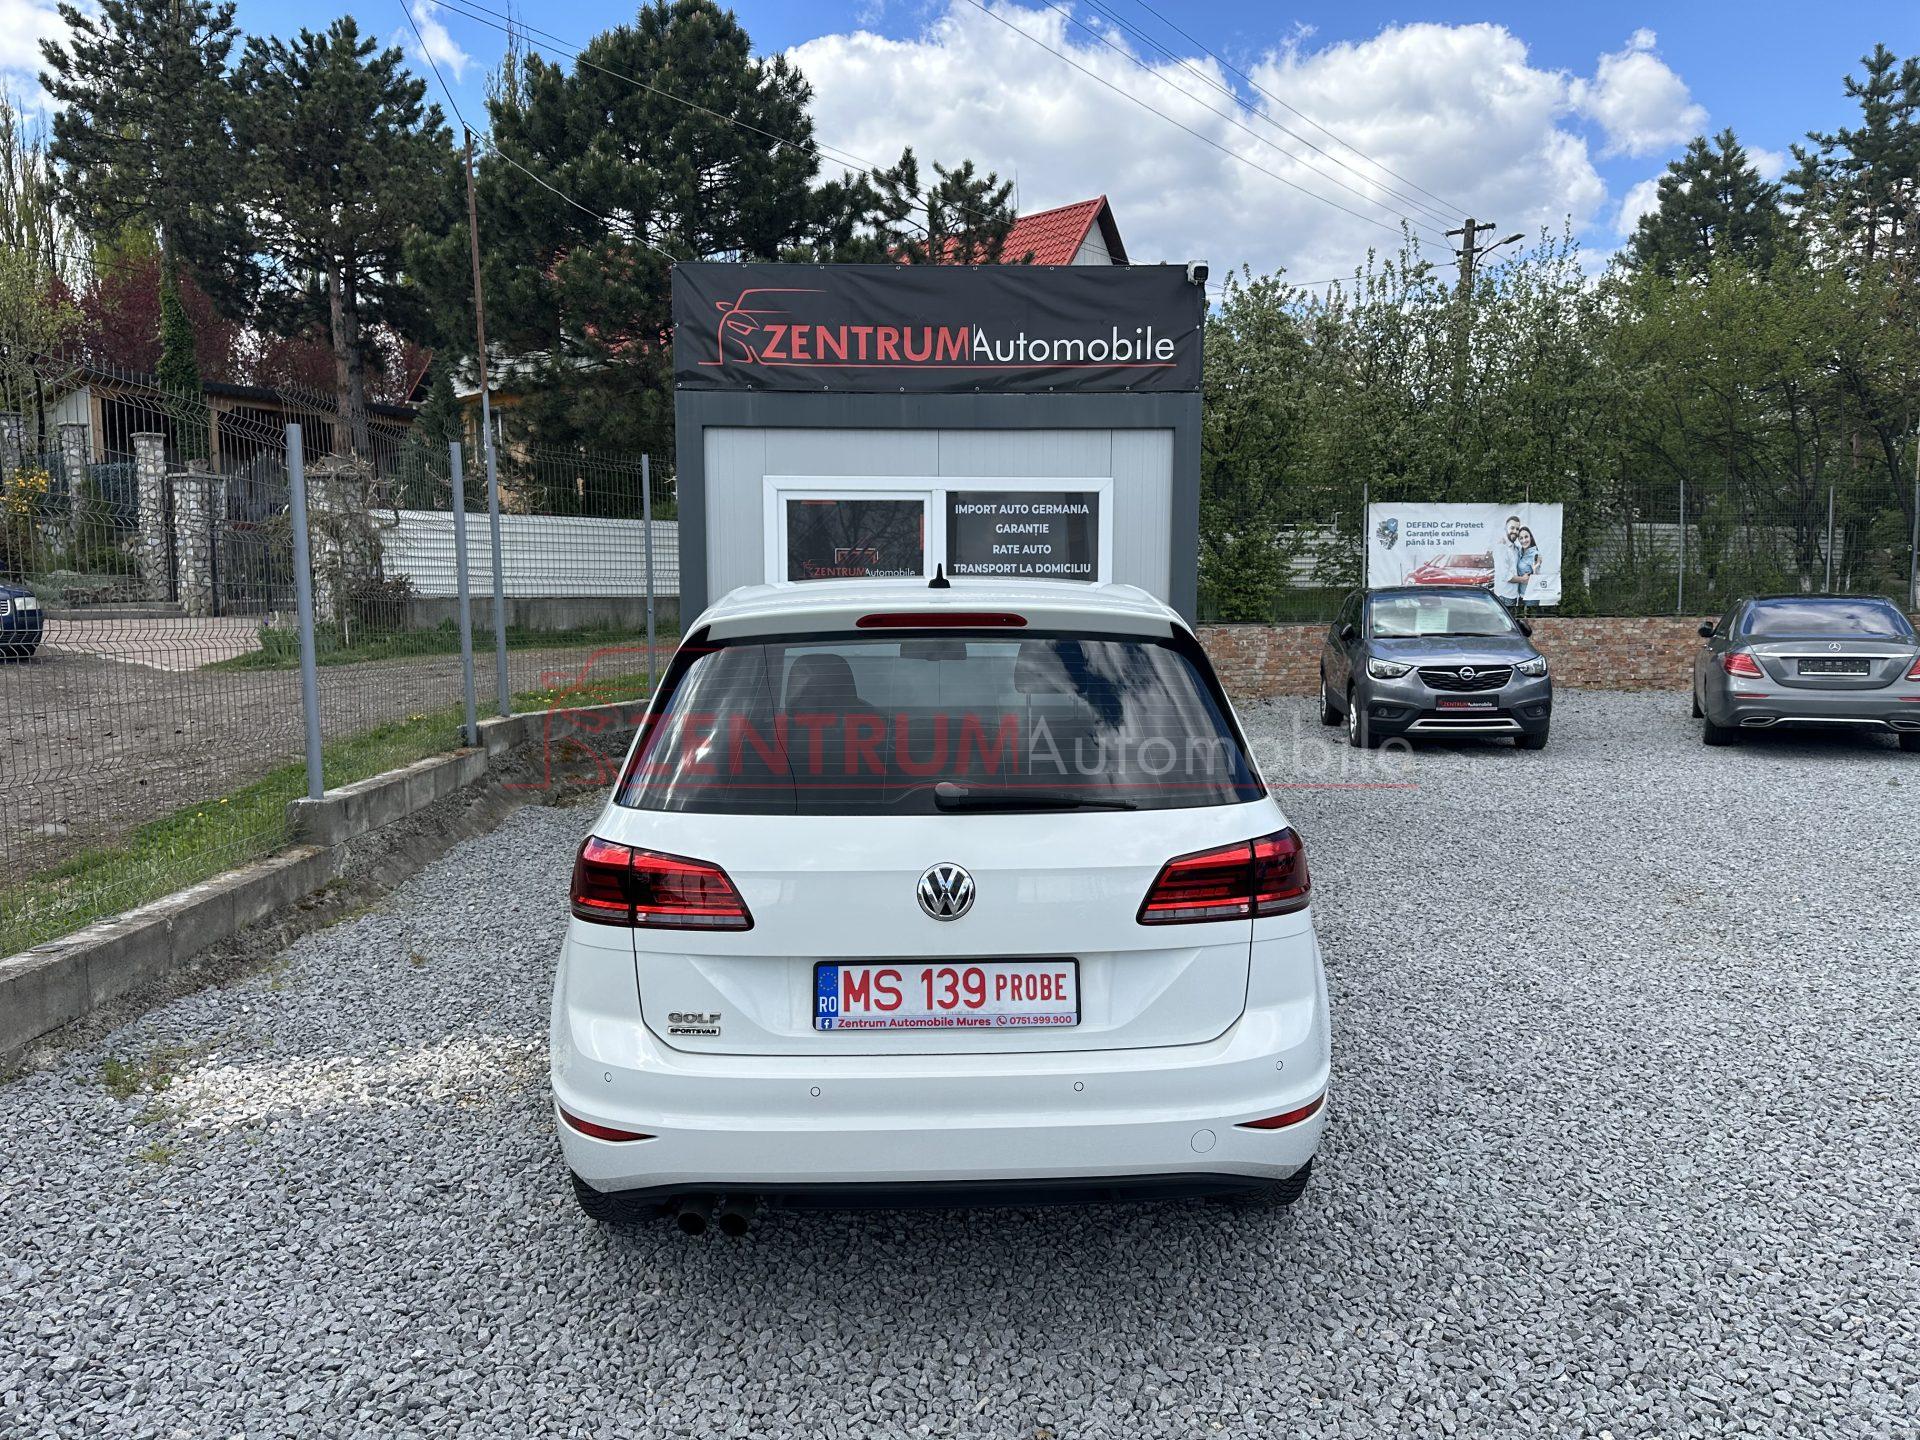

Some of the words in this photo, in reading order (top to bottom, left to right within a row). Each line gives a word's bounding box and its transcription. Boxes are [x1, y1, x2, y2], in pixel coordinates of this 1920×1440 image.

[761, 324, 970, 362] ZENTRUM
[974, 324, 1175, 362] Automobile
[955, 504, 996, 514] IMPORT
[999, 504, 1029, 514] AUTO
[1031, 504, 1089, 514] GERMANIA
[995, 523, 1050, 536] GARANȚIE
[1406, 521, 1439, 529] DEFEND
[1440, 521, 1454, 529] Car
[1455, 521, 1484, 529] Protect
[1427, 538, 1435, 546] la
[1435, 538, 1442, 546] 3
[1442, 538, 1456, 546] ani
[992, 544, 1020, 554] RATE
[1021, 544, 1052, 554] AUTO
[953, 563, 1018, 573] TRANSPORT
[1019, 564, 1034, 573] LA
[1035, 564, 1092, 574] DOMICILIU
[843, 969, 903, 1012] MS
[921, 967, 986, 1010] 139
[995, 973, 1067, 1001] PROBE
[819, 996, 837, 1013] RO
[668, 1011, 721, 1024] GOLF
[838, 1018, 886, 1028] Zentrum
[888, 1016, 954, 1027] Automobile
[956, 1016, 991, 1026] Mures
[1009, 1015, 1072, 1025] 0751.999.900
